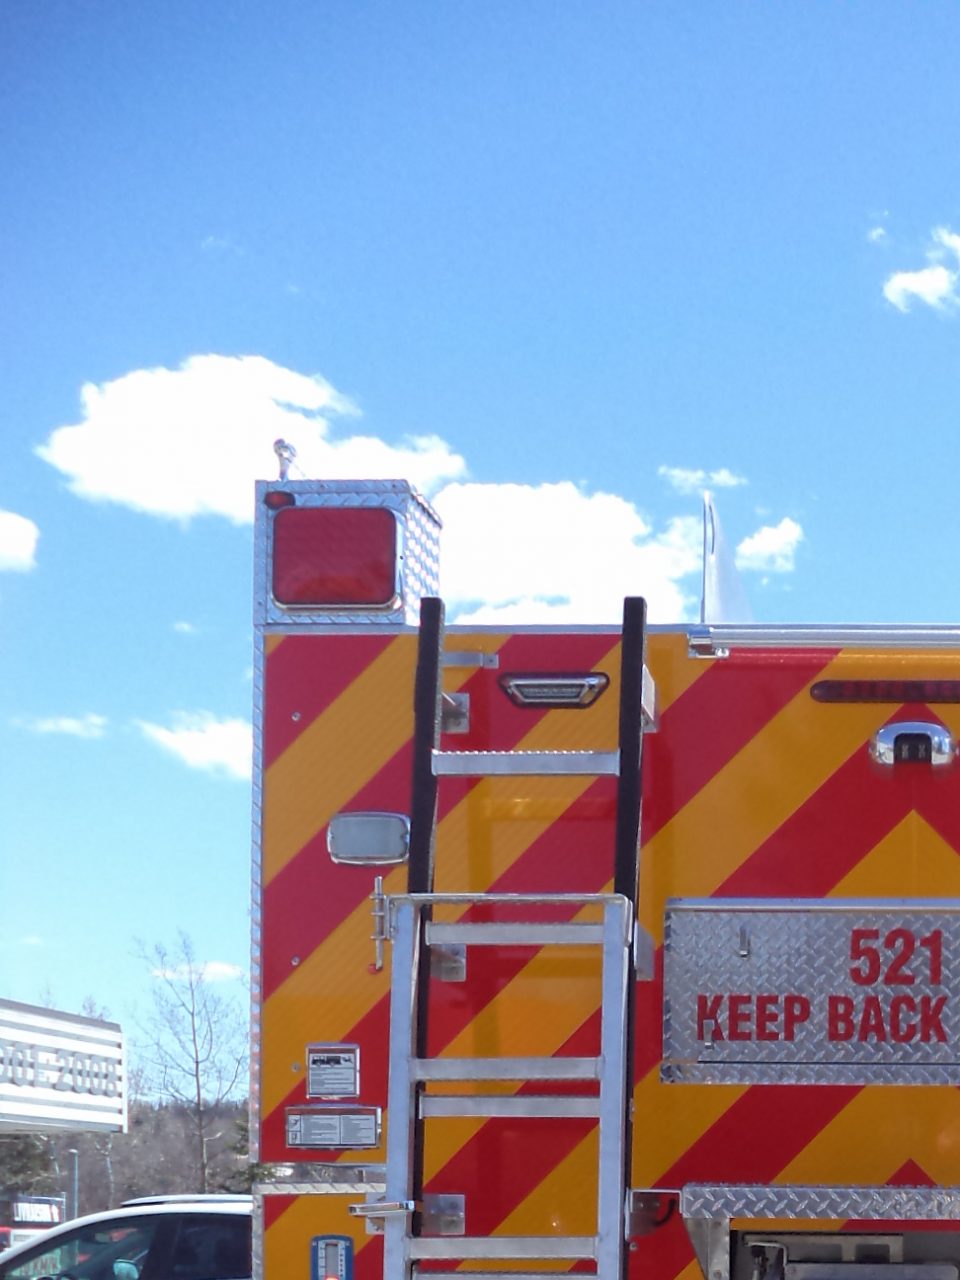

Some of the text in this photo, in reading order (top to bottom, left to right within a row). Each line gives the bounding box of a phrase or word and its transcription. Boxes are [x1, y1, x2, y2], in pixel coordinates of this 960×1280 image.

[849, 928, 944, 986] 521
[697, 994, 811, 1042] KEEP
[827, 996, 949, 1043] BACK
[54, 1048, 117, 1097] 2008
